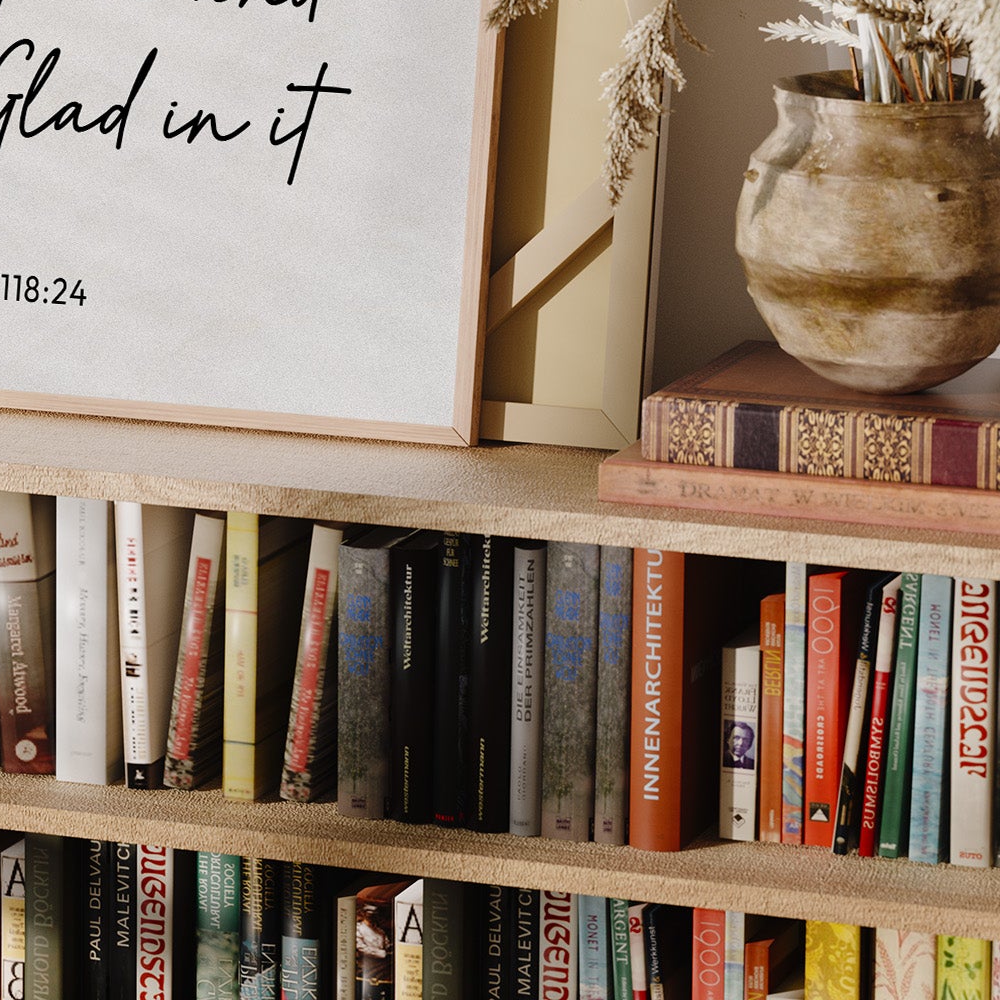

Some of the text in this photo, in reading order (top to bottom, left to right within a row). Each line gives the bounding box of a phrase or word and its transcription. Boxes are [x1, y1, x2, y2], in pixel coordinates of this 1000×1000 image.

[162, 101, 250, 144] in
[269, 61, 352, 186] it
[1, 273, 88, 307] 118:24
[7, 595, 25, 659] Margaret
[403, 563, 414, 671] Weltarchitektur
[515, 572, 526, 722] DIE EINSAMKEIT
[523, 558, 536, 723] DER PRIMZAHLEN
[643, 548, 664, 801] INNENARCHITEKTU
[403, 745, 411, 814] westermann
[477, 736, 486, 821] westermann
[89, 839, 102, 961] PAUL DELVAU
[399, 903, 424, 945] A
[489, 885, 502, 957] DELVAU
[587, 914, 598, 970] MONET IN
[651, 925, 659, 975] Werkkunst
[694, 921, 721, 987] 1900
